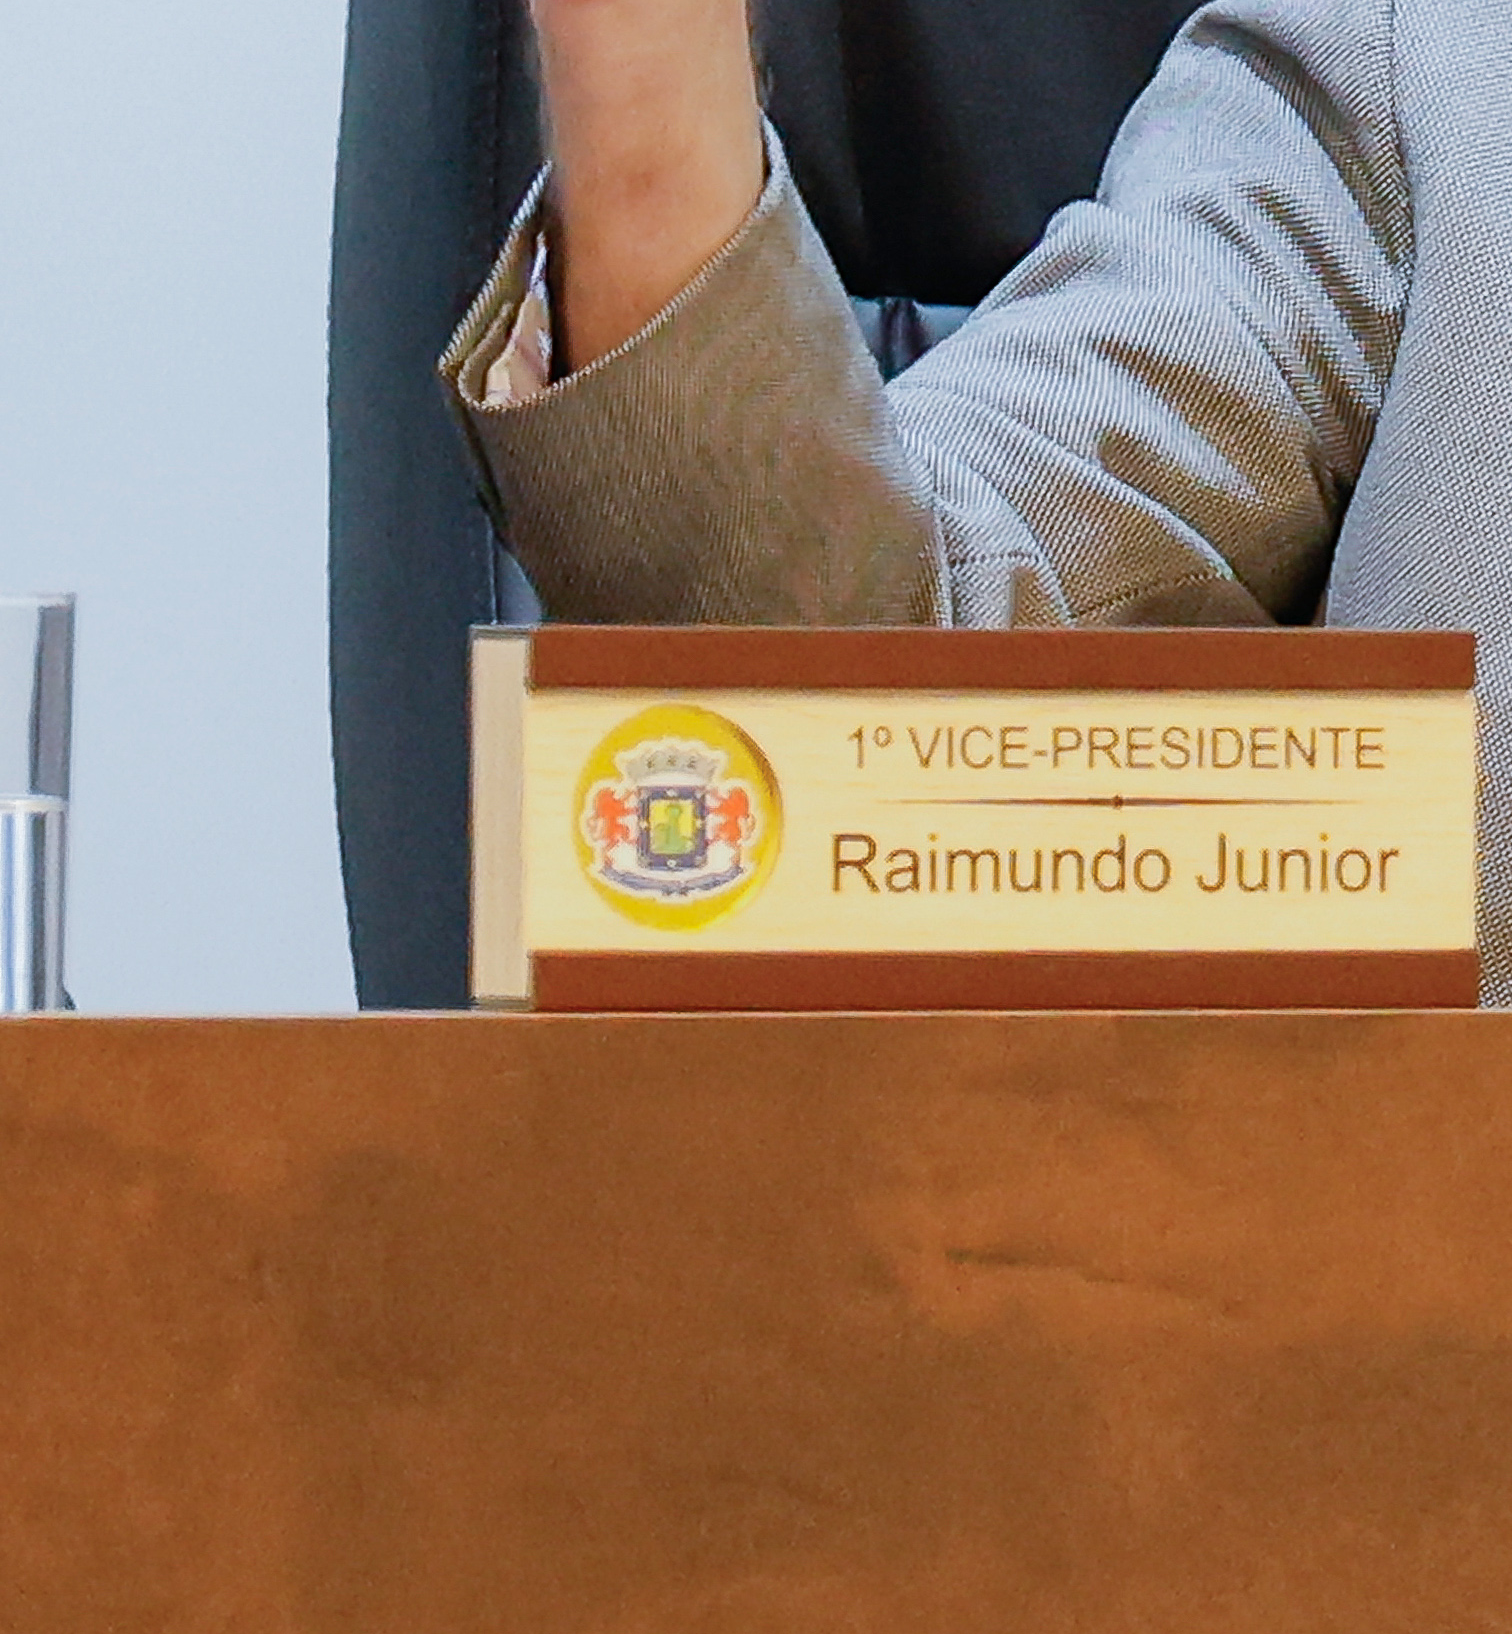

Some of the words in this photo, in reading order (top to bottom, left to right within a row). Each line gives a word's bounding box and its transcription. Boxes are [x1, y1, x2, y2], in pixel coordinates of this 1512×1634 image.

[847, 725, 893, 770] 1º
[906, 724, 1386, 770] VICE-PRESIDENTE
[831, 832, 1172, 895] Raimundo
[1194, 832, 1400, 894] Junior
